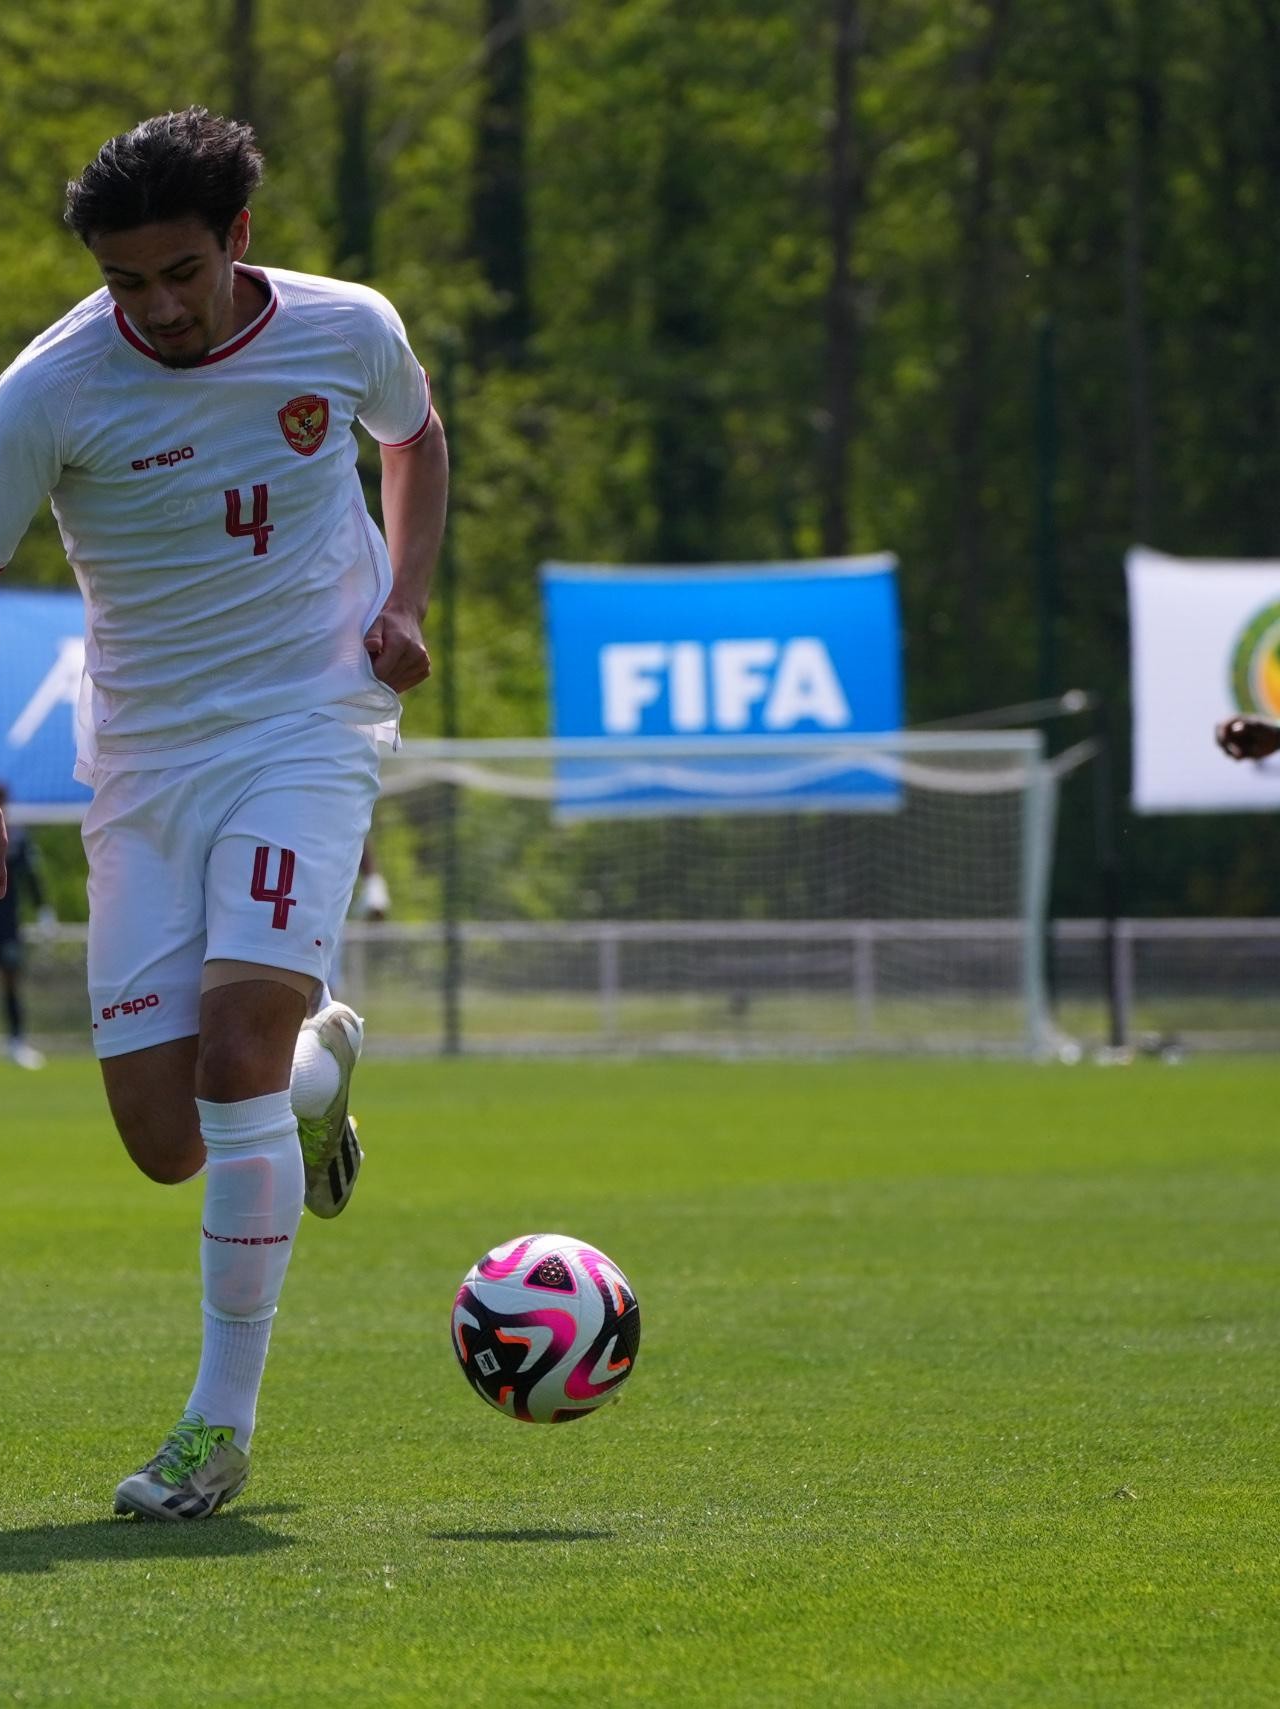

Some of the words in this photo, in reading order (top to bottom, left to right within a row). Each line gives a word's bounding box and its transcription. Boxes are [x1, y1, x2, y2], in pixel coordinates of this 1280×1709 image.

[131, 446, 195, 471] erspo
[224, 483, 274, 556] 4
[598, 635, 853, 733] FIFA
[250, 846, 297, 930] 4
[102, 994, 160, 1020] erspo
